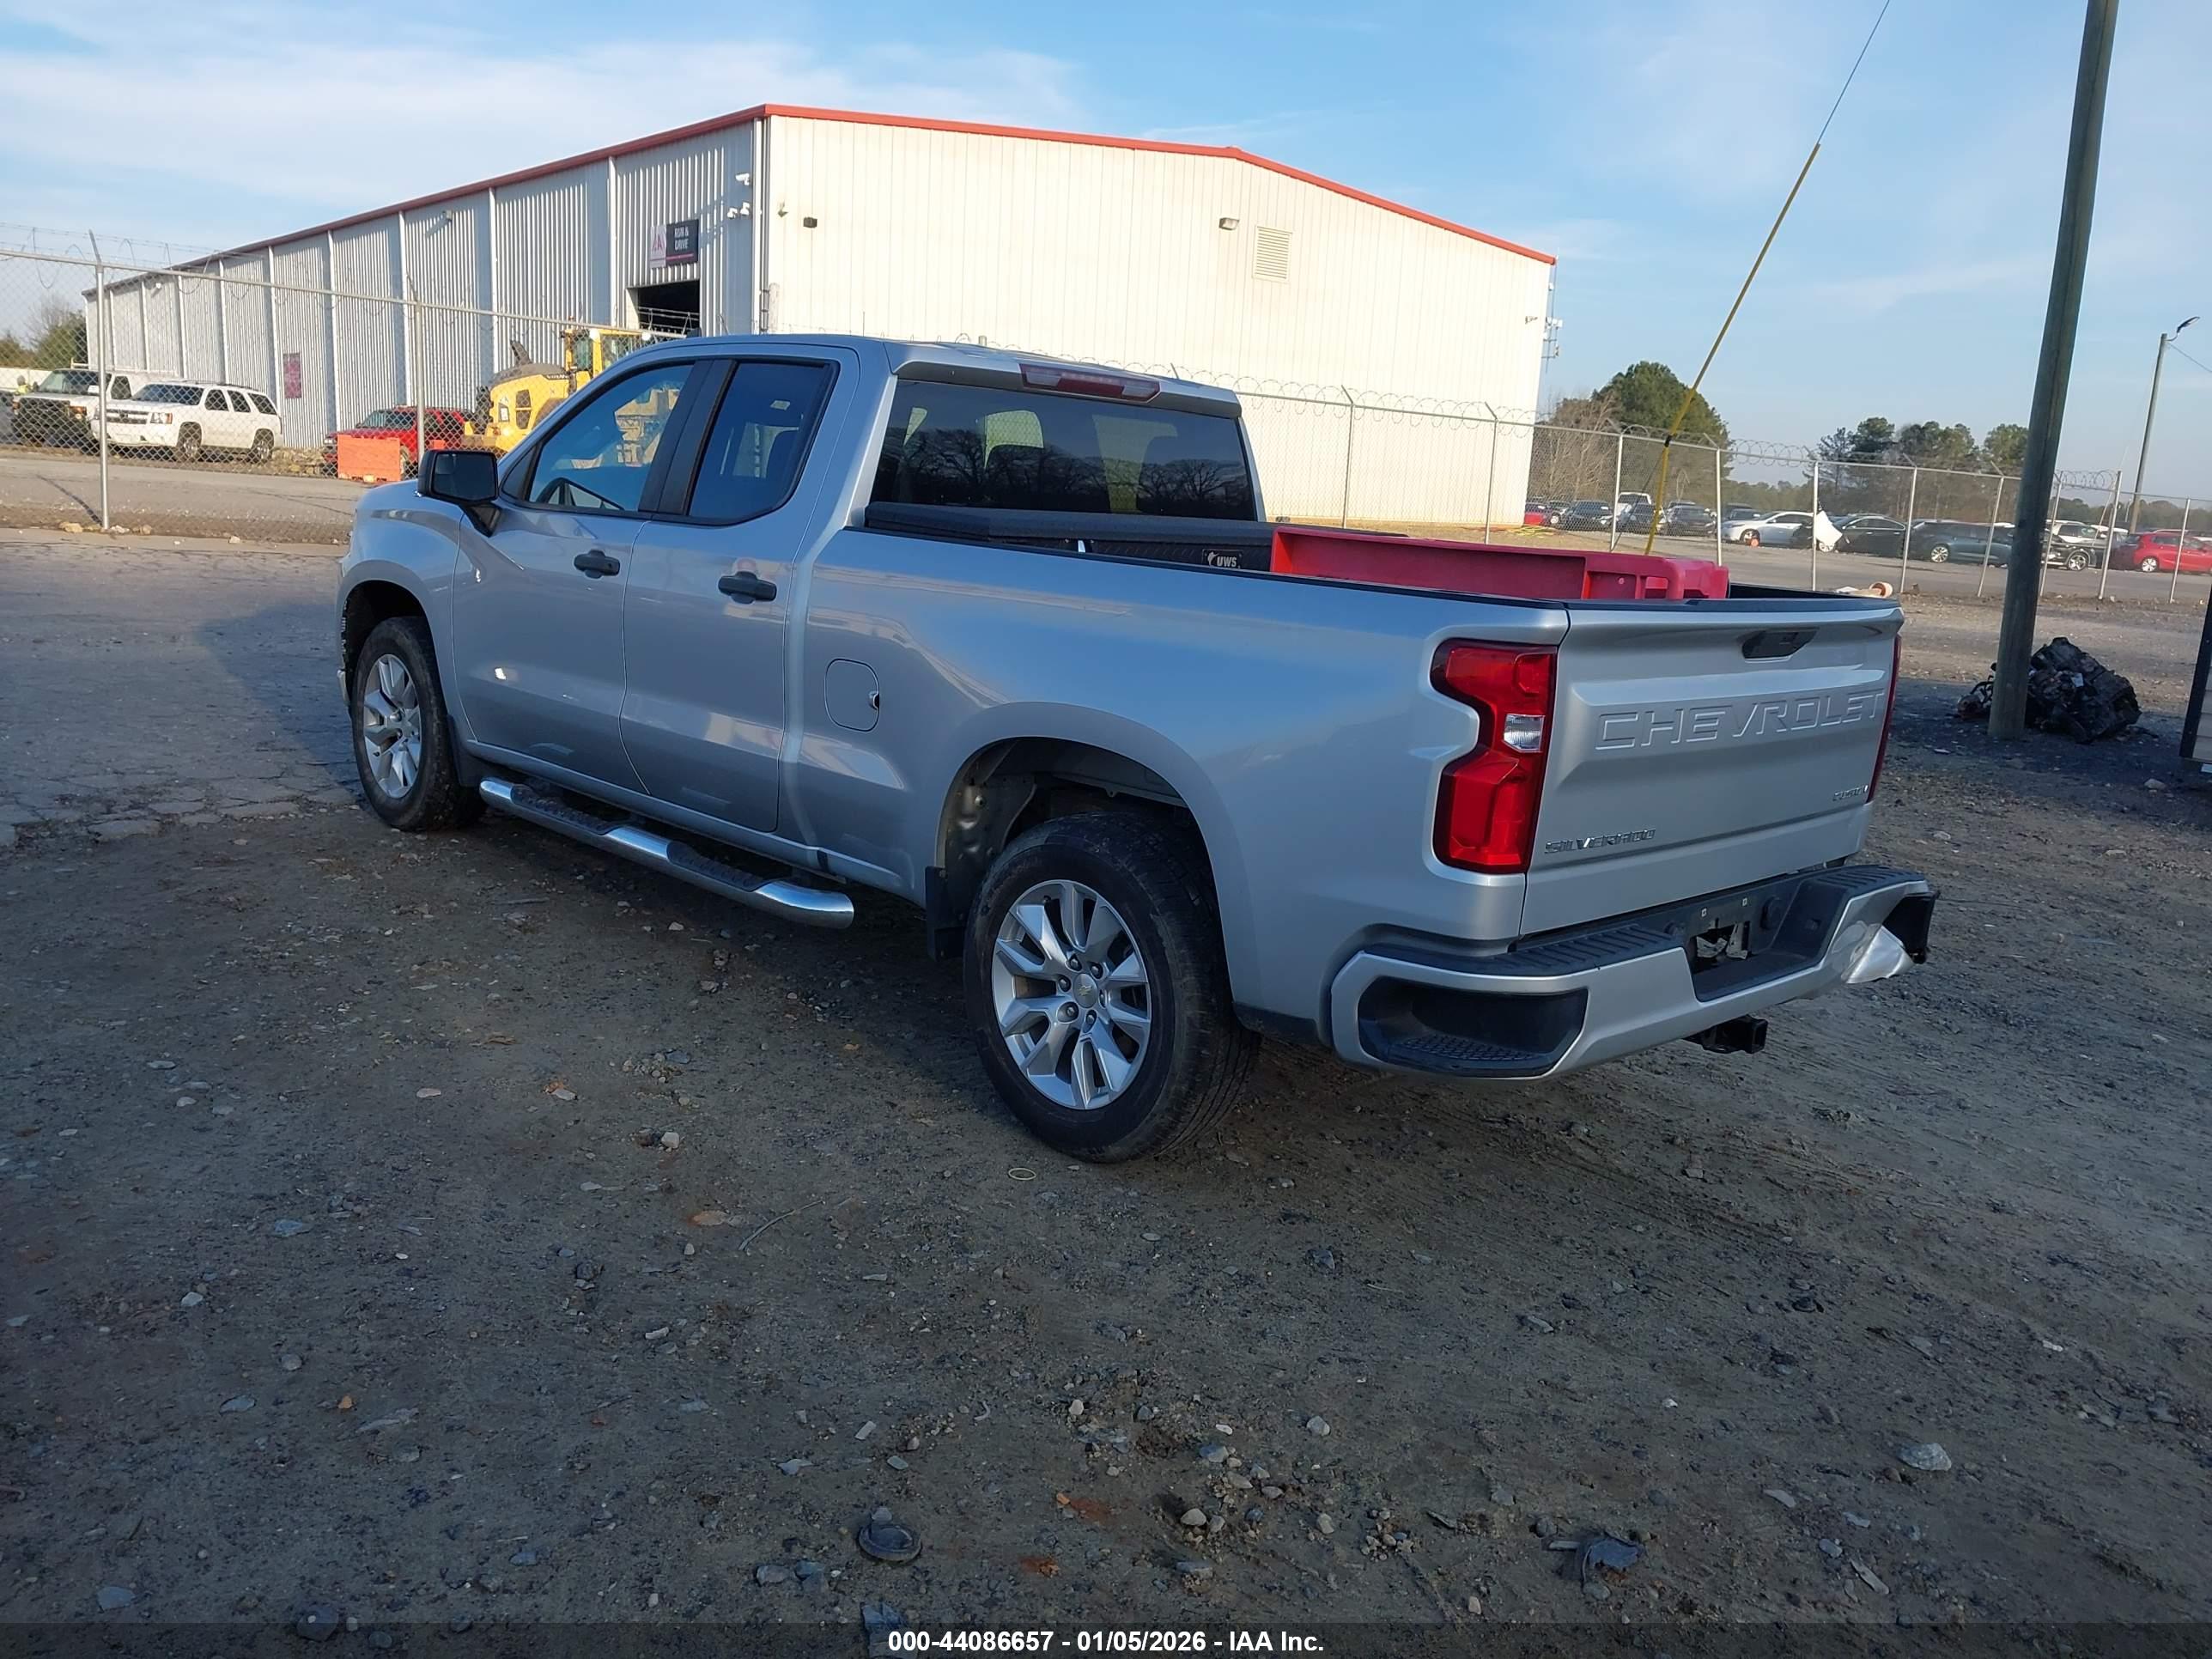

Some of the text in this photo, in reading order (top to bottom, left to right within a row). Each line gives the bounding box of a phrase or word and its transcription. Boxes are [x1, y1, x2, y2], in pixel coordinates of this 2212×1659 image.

[1217, 556, 1237, 567] UWS
[1595, 690, 1885, 750] CHEVROLET
[1544, 829, 1656, 854] SILVERADO
